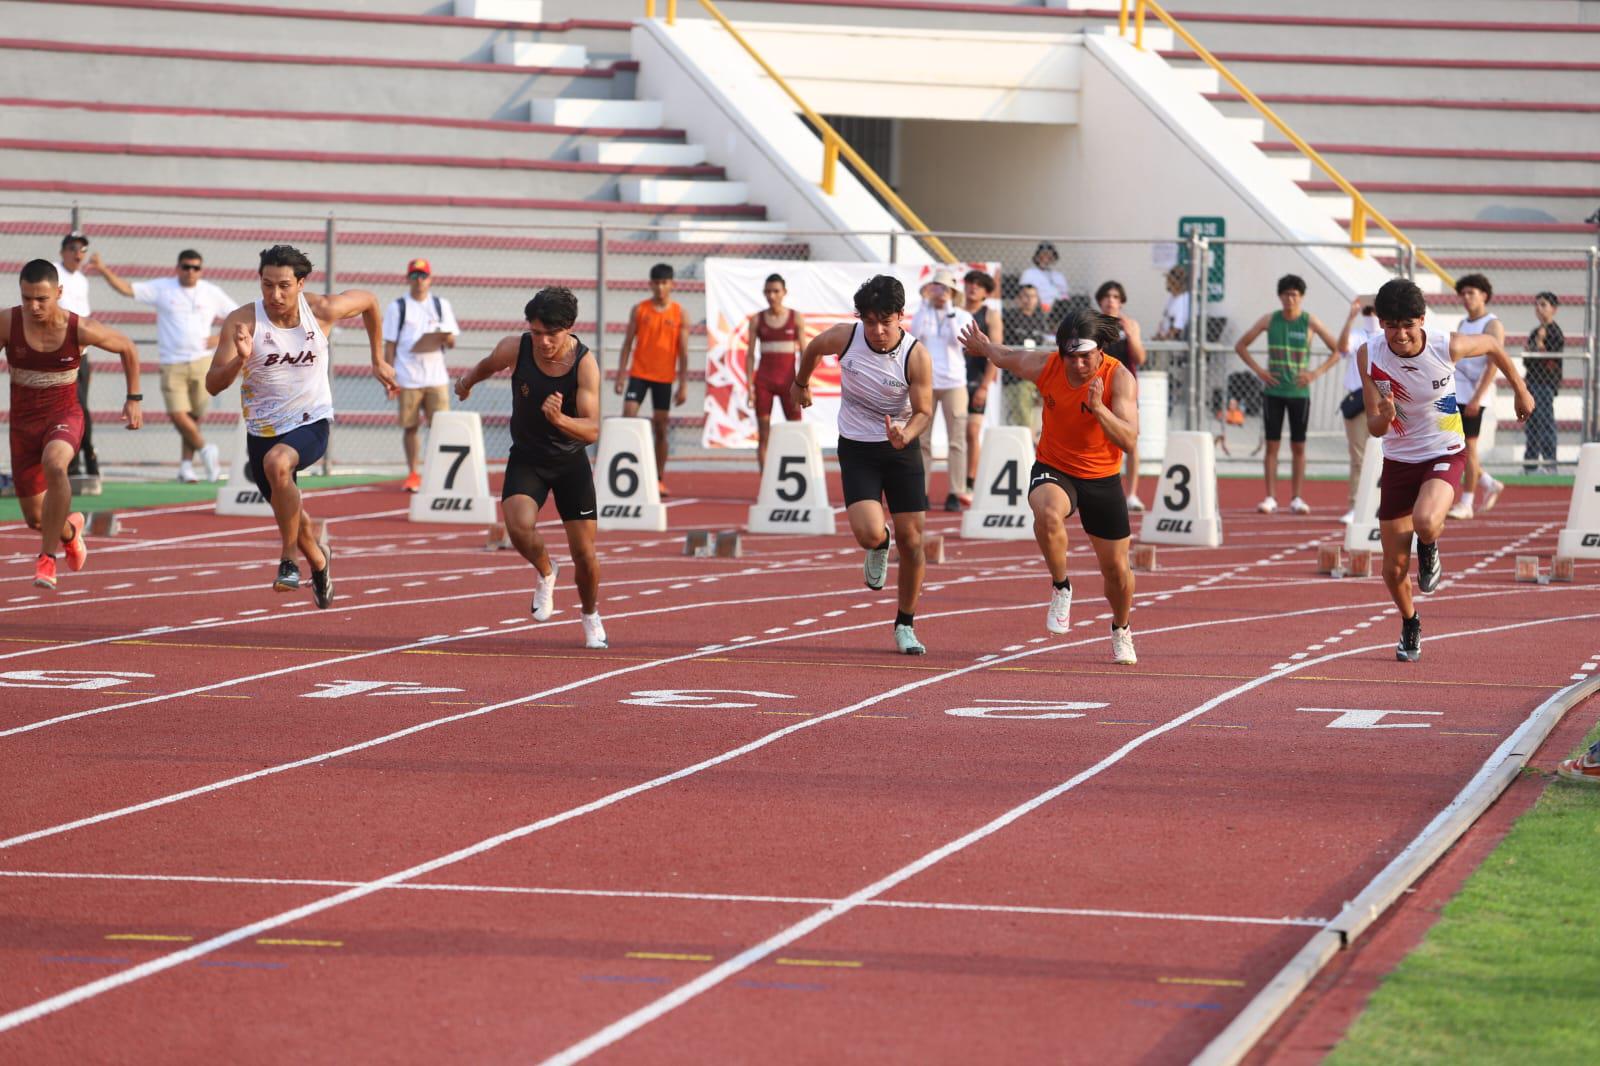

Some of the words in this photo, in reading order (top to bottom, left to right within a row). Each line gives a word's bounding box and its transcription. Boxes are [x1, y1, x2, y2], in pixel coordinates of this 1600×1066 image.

[264, 350, 316, 366] BAJA
[439, 445, 470, 490] 7
[608, 451, 639, 498] 6
[776, 456, 807, 503] 5
[990, 460, 1022, 506] 4
[1163, 464, 1191, 512] 3
[235, 491, 265, 503] GIL
[431, 498, 472, 511] GILL
[600, 505, 642, 518] GILL
[768, 509, 811, 522] GILL
[983, 514, 1026, 528] GILL
[1156, 518, 1193, 533] GILL
